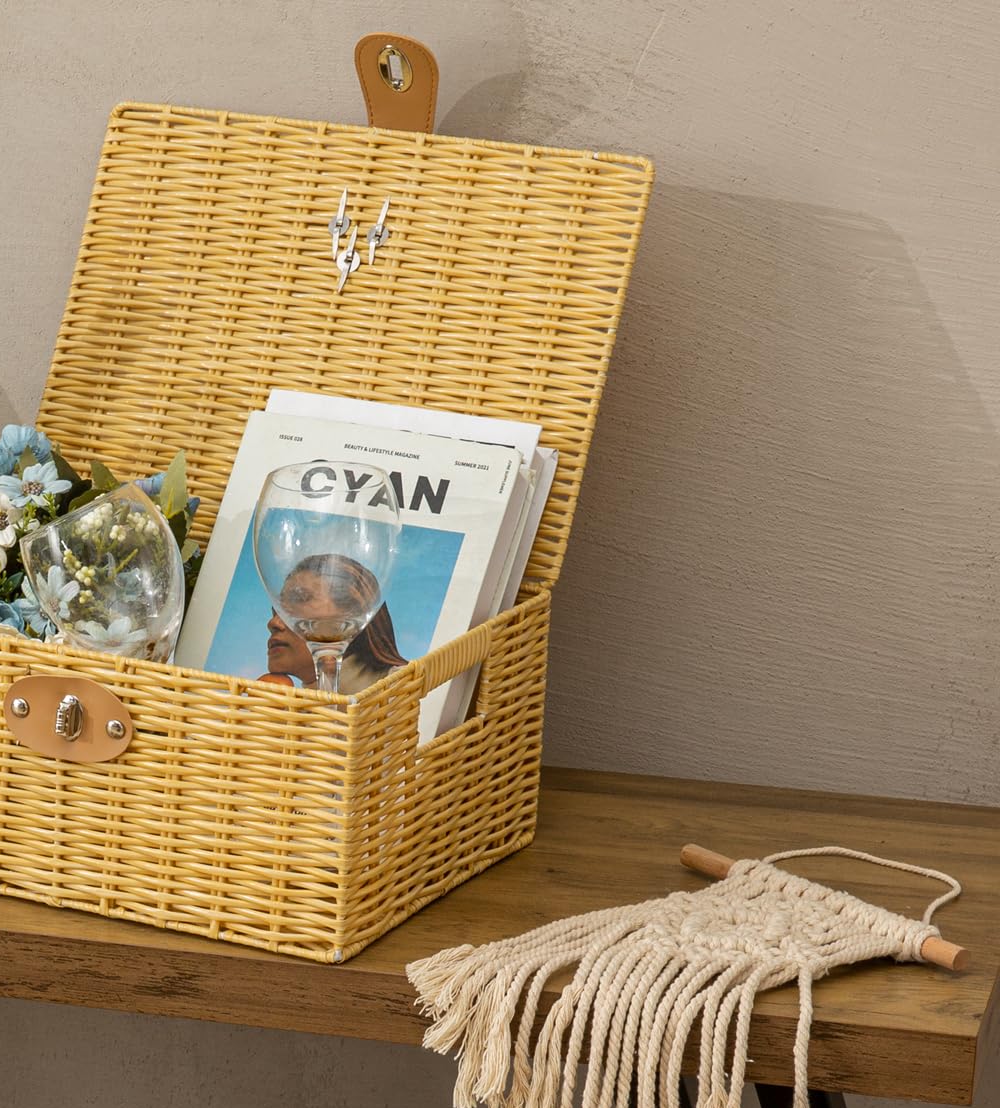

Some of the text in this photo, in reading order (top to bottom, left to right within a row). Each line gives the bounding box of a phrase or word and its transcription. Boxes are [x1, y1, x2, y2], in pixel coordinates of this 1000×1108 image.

[344, 443, 364, 452] BEAUTY
[369, 447, 394, 456] LIFESTYLE
[395, 450, 420, 460] MAGAZINE
[454, 460, 489, 471] SUMMER 2021
[300, 459, 451, 515] CYAN
